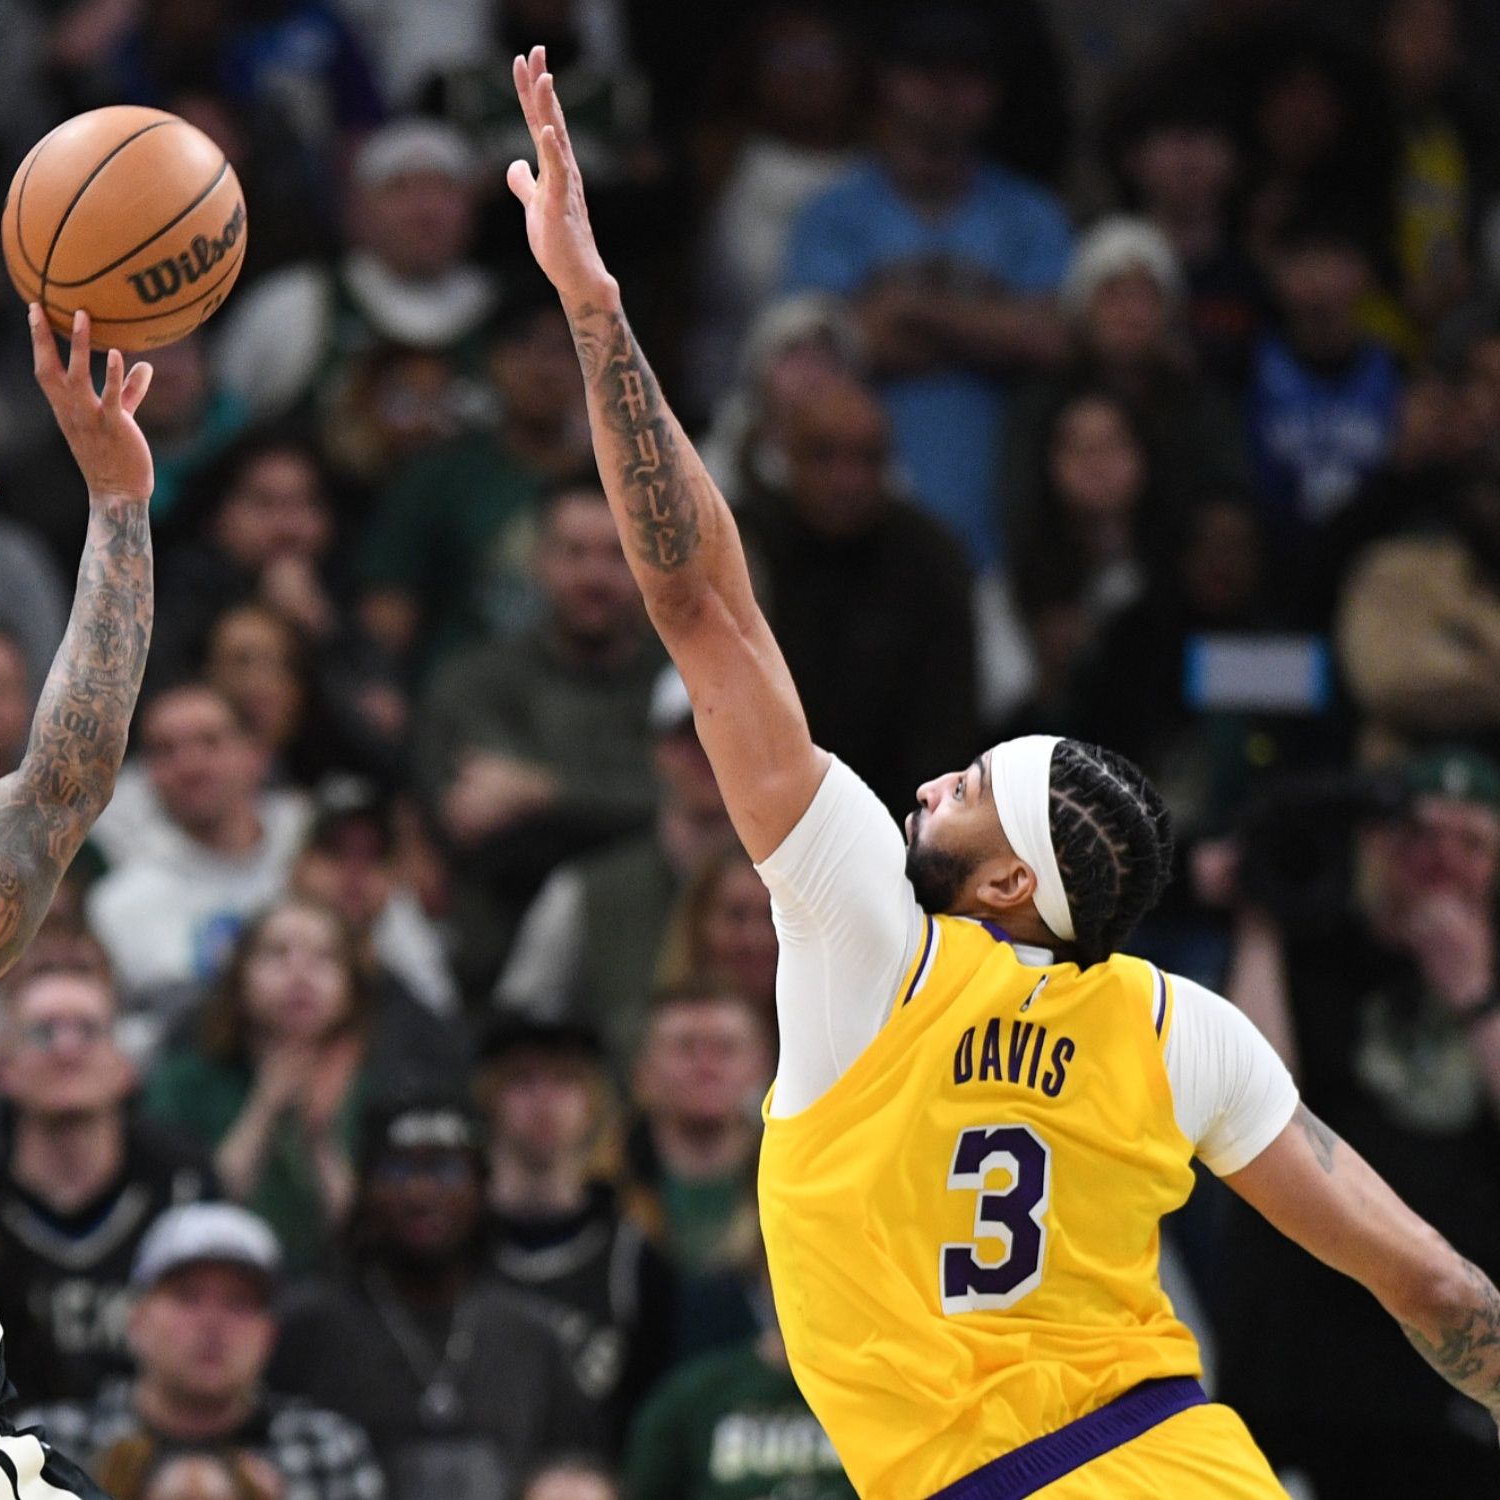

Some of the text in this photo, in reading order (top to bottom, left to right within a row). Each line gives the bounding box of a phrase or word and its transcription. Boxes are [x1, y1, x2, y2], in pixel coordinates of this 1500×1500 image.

[127, 202, 246, 304] Wilson
[954, 1017, 1075, 1098] DAVIS
[939, 1123, 1051, 1315] 3
